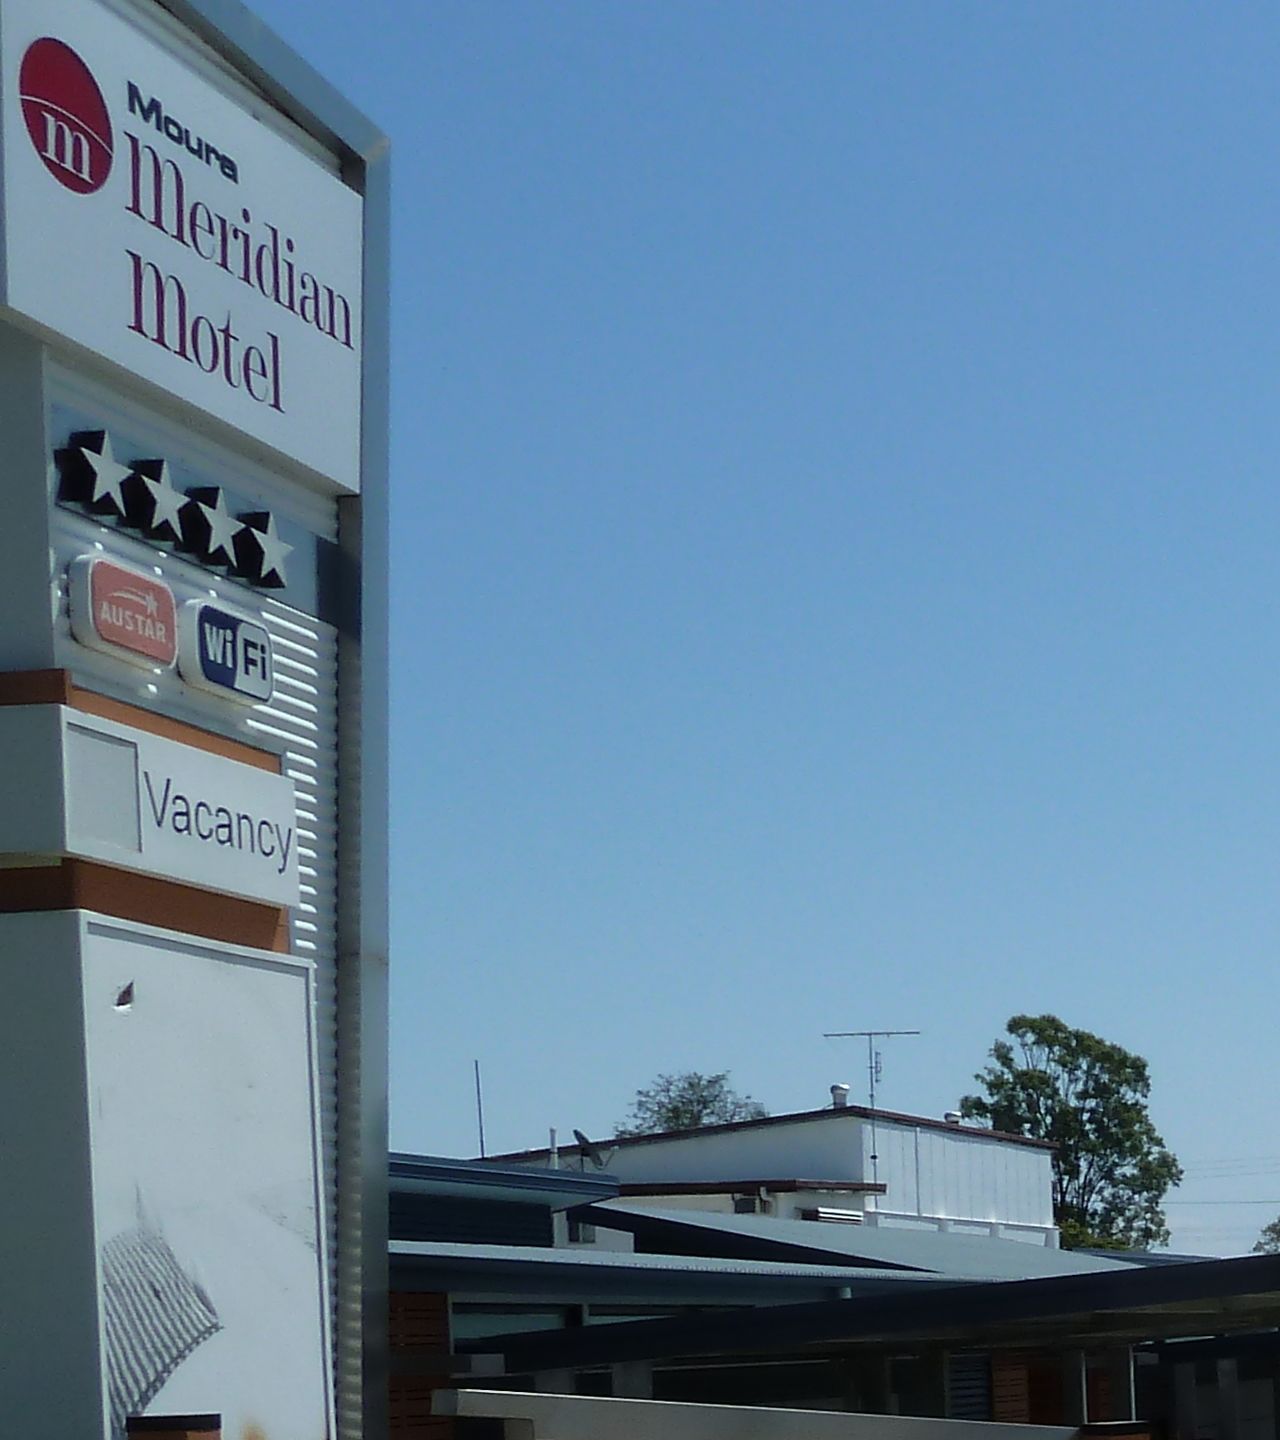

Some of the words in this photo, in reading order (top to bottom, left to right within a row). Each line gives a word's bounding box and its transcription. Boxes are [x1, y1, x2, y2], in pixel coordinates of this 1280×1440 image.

[127, 80, 239, 184] Moura
[100, 601, 166, 643] AUSTAR
[143, 770, 292, 874] Vacancy
